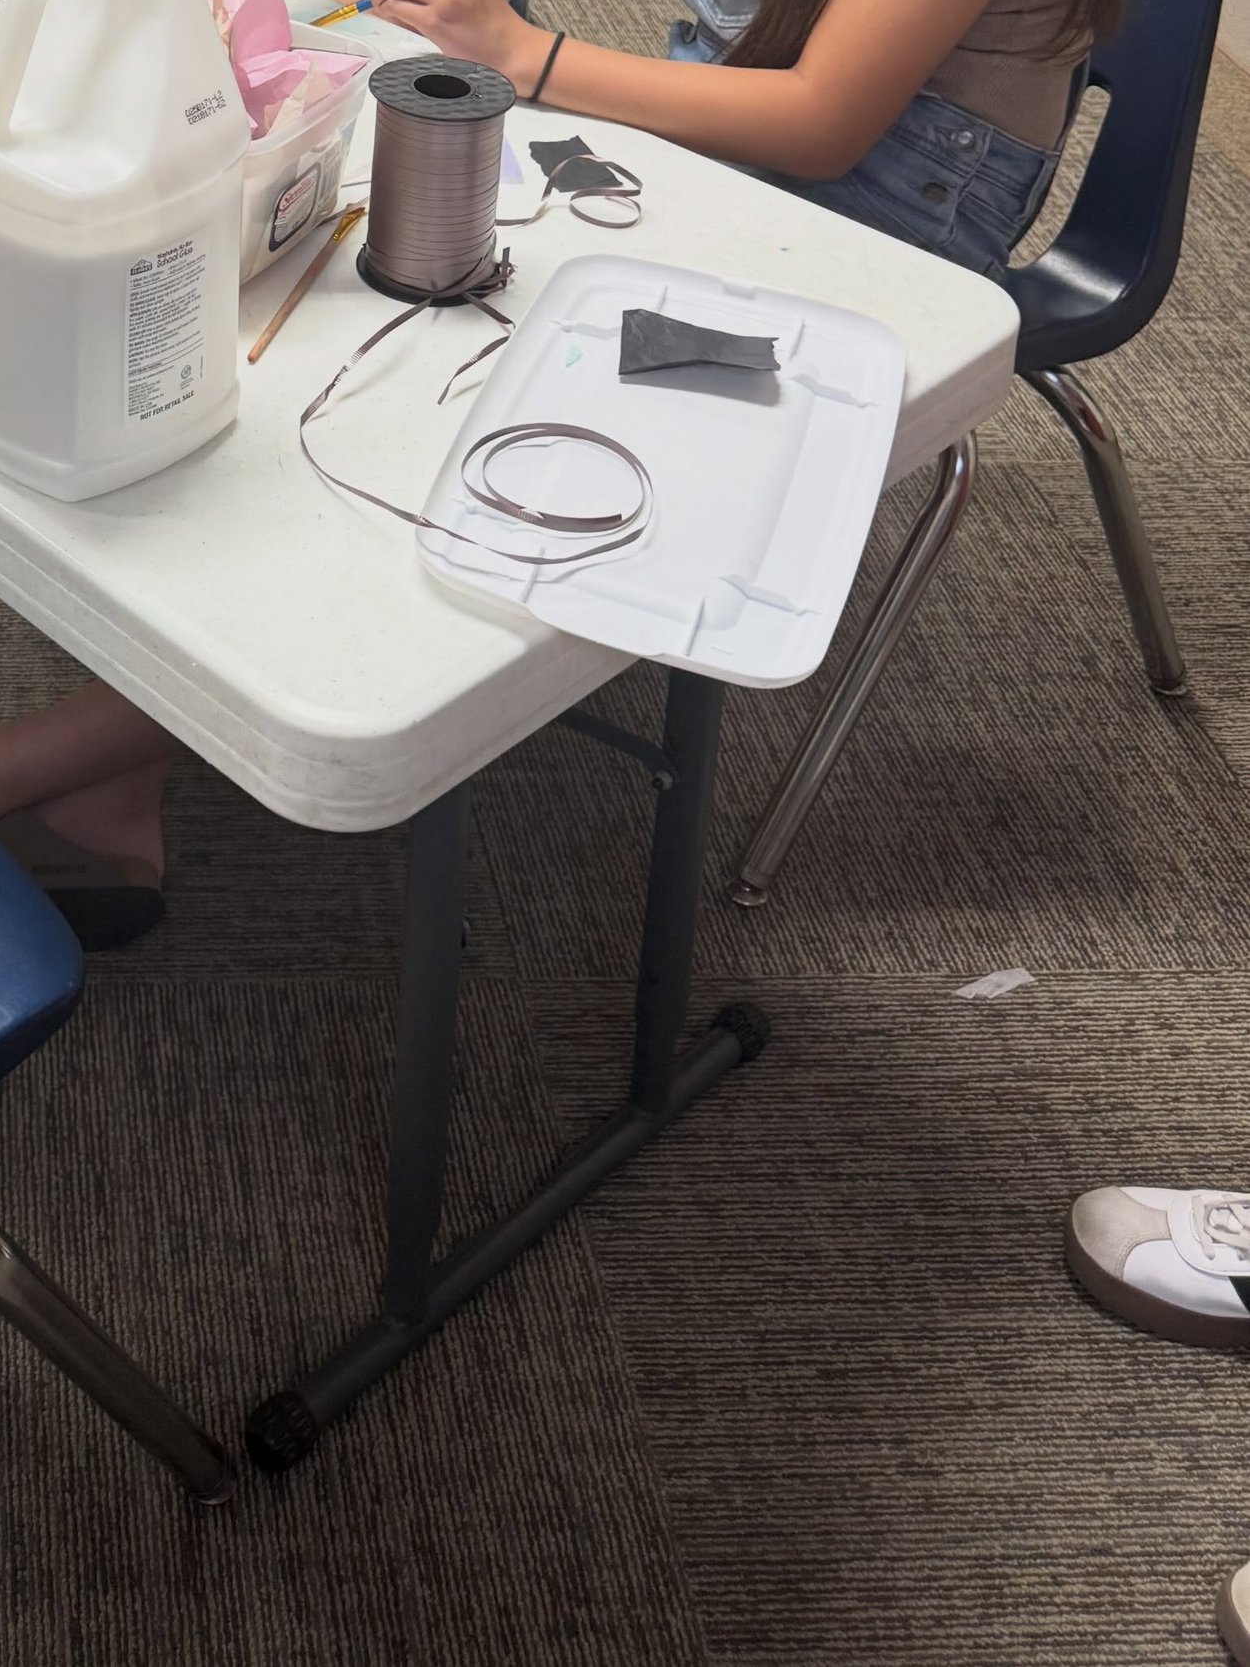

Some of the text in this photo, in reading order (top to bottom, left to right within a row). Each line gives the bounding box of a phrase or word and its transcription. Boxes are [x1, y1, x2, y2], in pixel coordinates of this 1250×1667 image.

[157, 252, 179, 268] School
[140, 410, 152, 421] NOT
[182, 390, 194, 402] SALE
